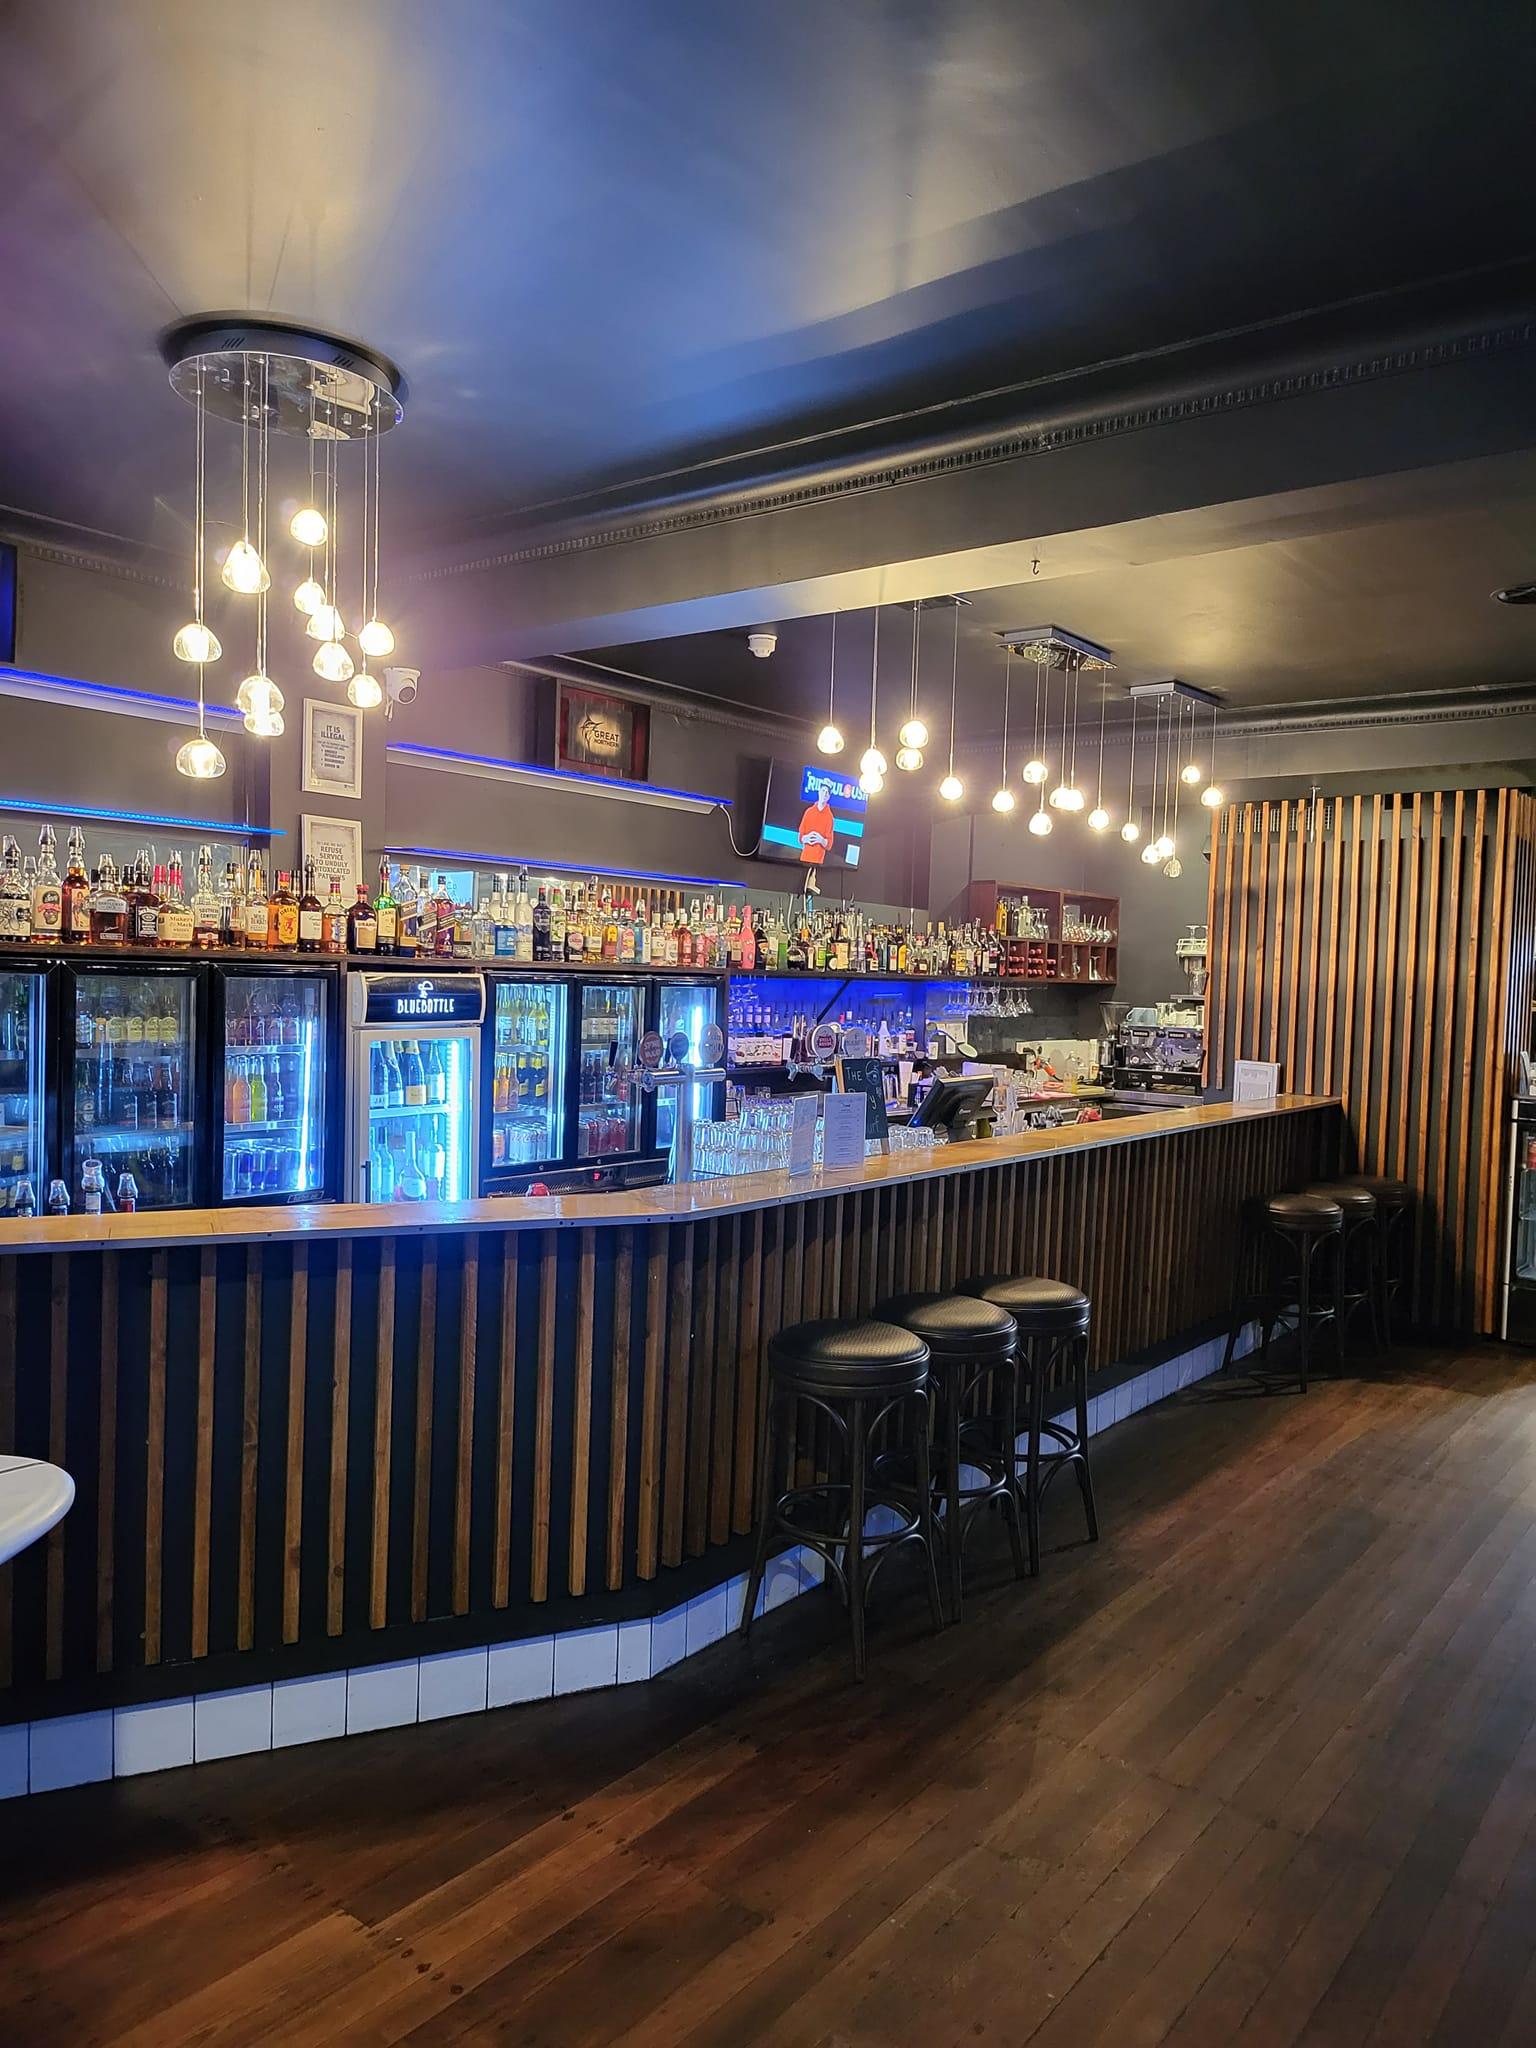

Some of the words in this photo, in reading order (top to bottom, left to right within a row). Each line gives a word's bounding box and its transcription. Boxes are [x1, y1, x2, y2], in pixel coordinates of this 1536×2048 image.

[333, 726, 341, 734] IS
[320, 731, 346, 742] ILLEGAL
[594, 730, 620, 742] GREAT
[320, 846, 343, 854] REFUSE
[319, 853, 344, 861] SERVICE
[325, 860, 348, 868] UNDULY
[397, 998, 455, 1014] BLUEBOTTLE
[845, 1066, 863, 1081] THE
